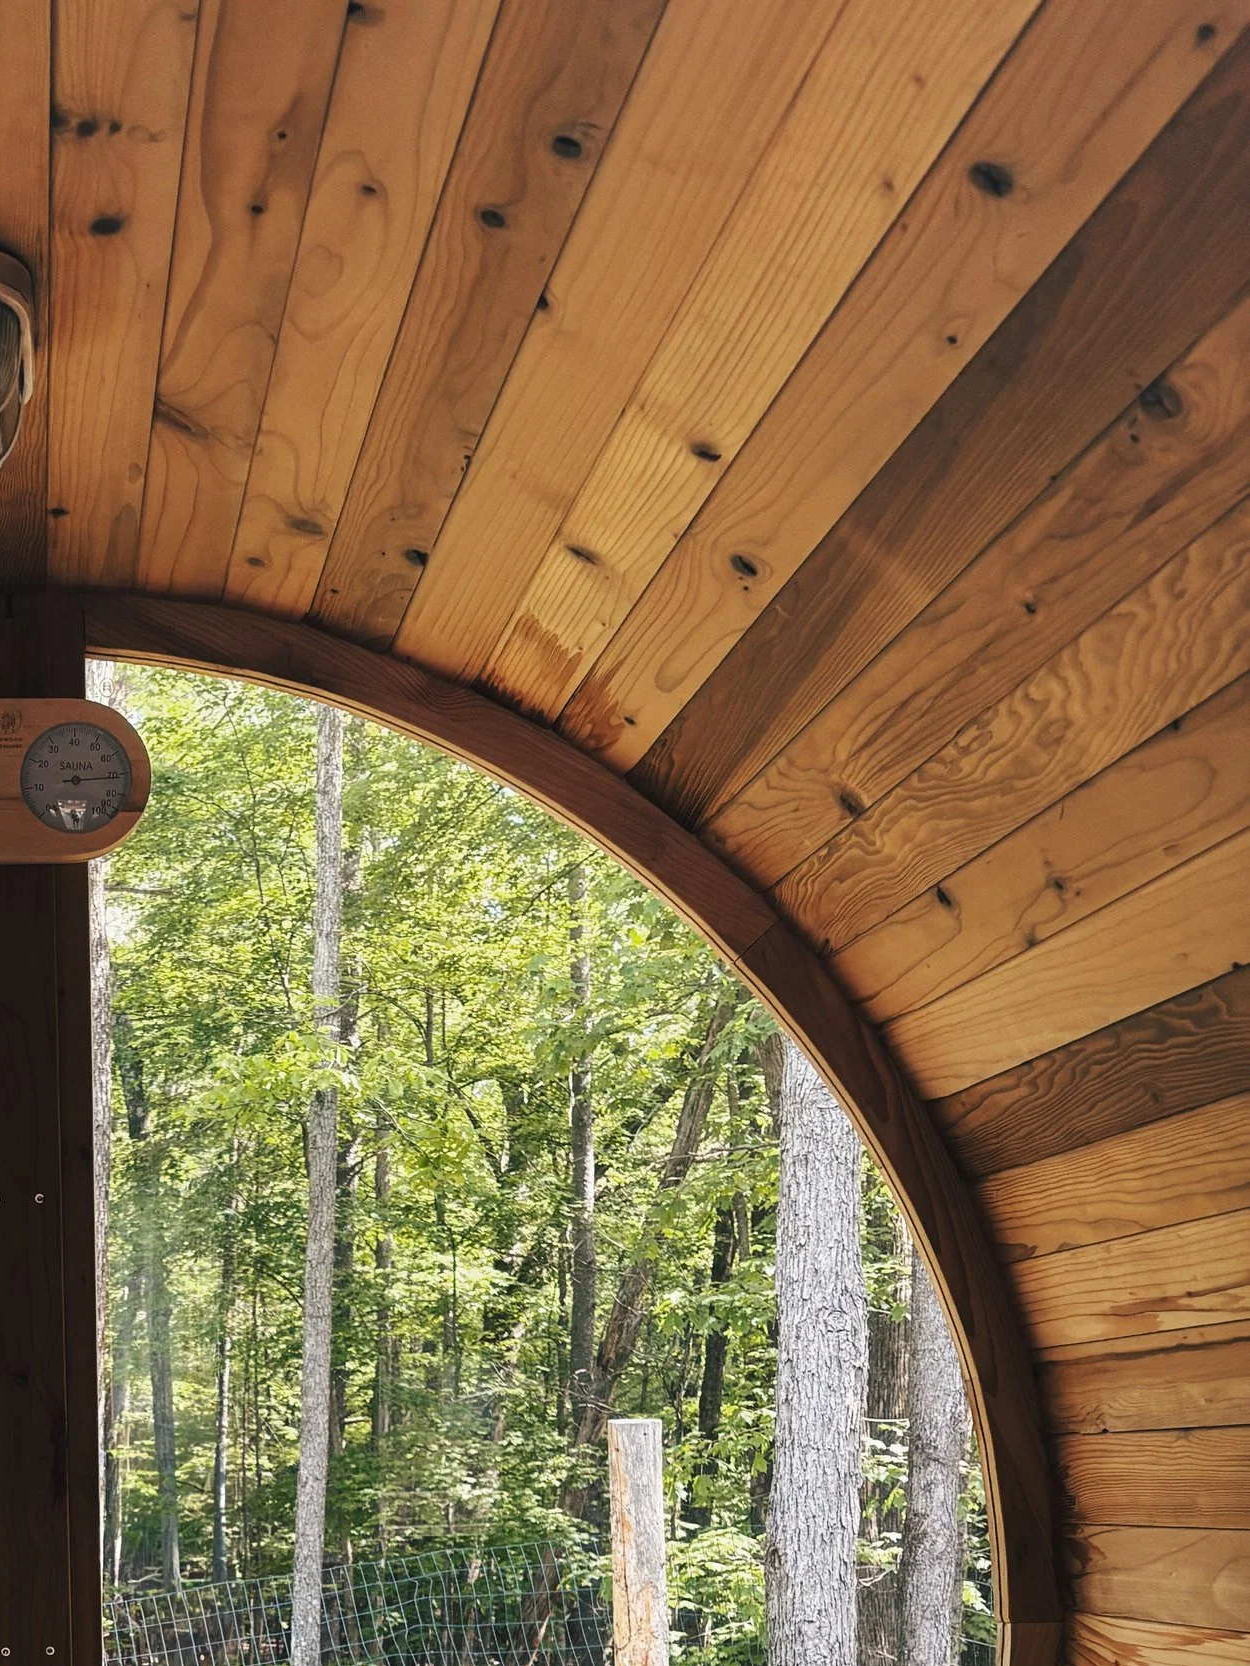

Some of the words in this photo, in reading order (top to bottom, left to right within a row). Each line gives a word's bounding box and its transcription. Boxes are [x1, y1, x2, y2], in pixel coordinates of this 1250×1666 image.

[69, 738, 80, 746] 40
[48, 745, 59, 753] 30
[90, 743, 101, 751] 50
[100, 754, 111, 763] 60
[38, 760, 49, 768] 20
[59, 761, 93, 771] SAUNA
[107, 771, 118, 779] 70
[33, 783, 44, 791] 10
[106, 789, 117, 797] 80
[100, 799, 111, 807] 90
[91, 806, 107, 815] 100
